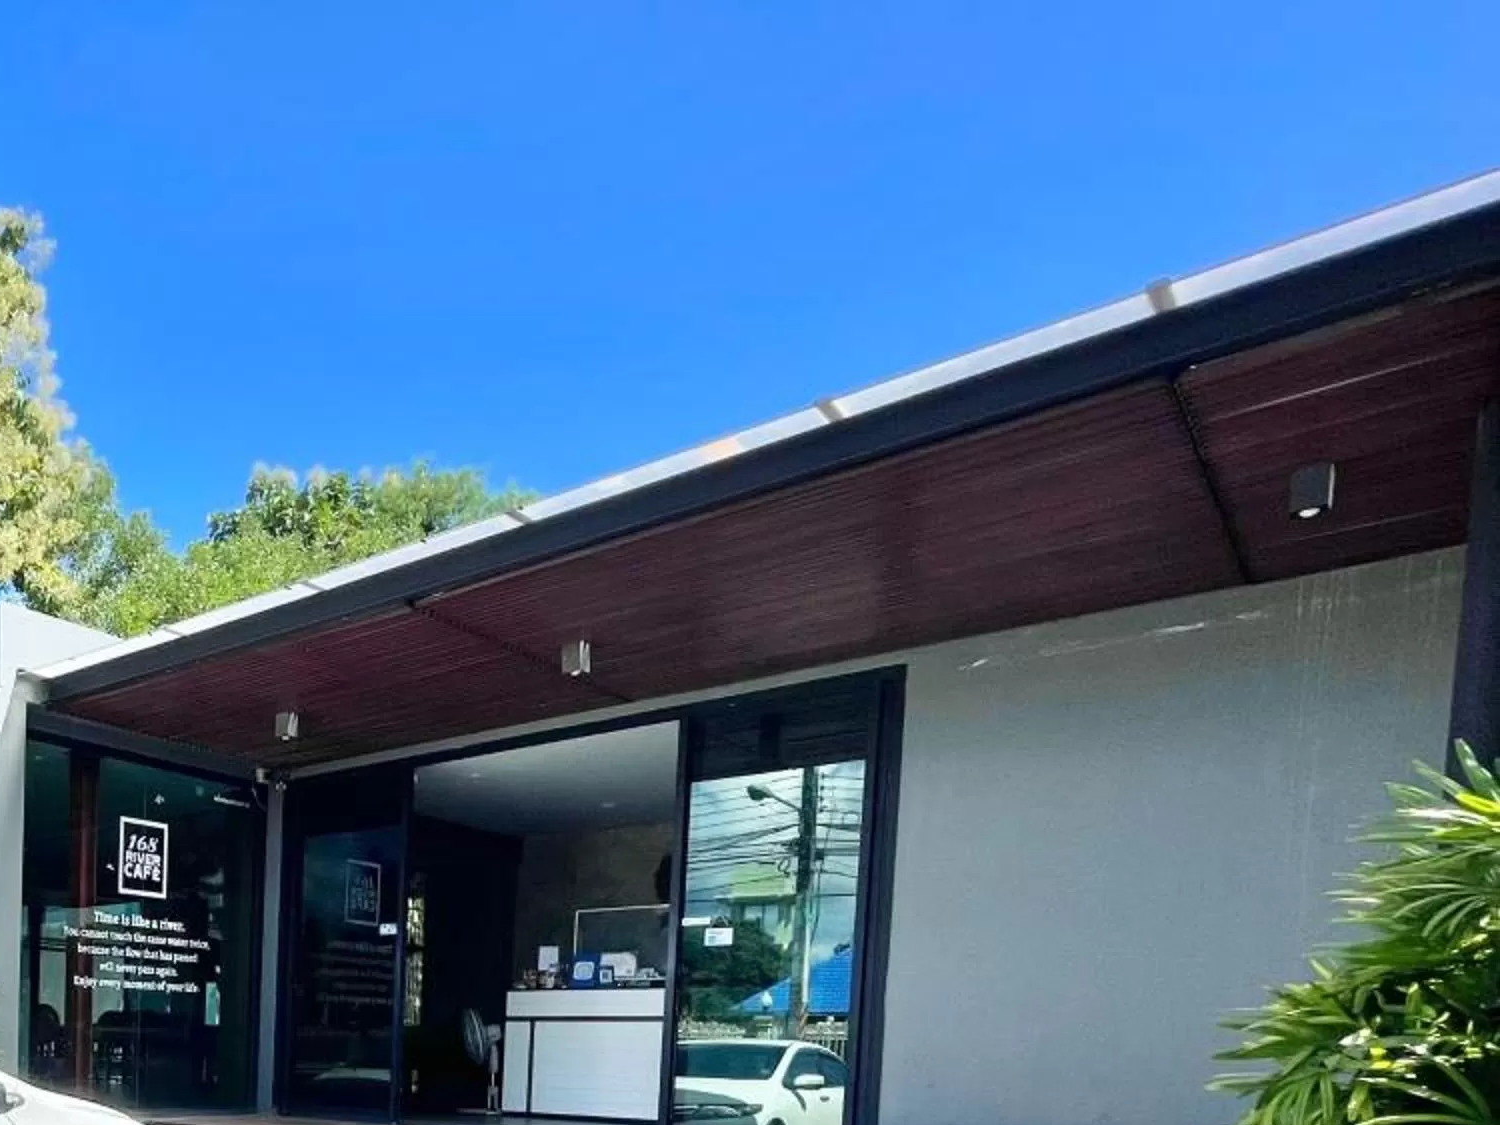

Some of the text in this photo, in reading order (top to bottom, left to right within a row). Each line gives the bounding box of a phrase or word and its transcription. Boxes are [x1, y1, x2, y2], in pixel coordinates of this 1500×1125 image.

[128, 834, 159, 853] 168
[125, 849, 161, 867] RIVER
[94, 910, 119, 925] Time
[121, 913, 130, 926] is
[131, 913, 150, 929] like
[151, 919, 158, 929] a
[133, 932, 146, 943] the
[77, 942, 109, 955] because
[111, 945, 124, 956] the
[143, 947, 159, 959] that
[73, 975, 97, 989] Enjoy
